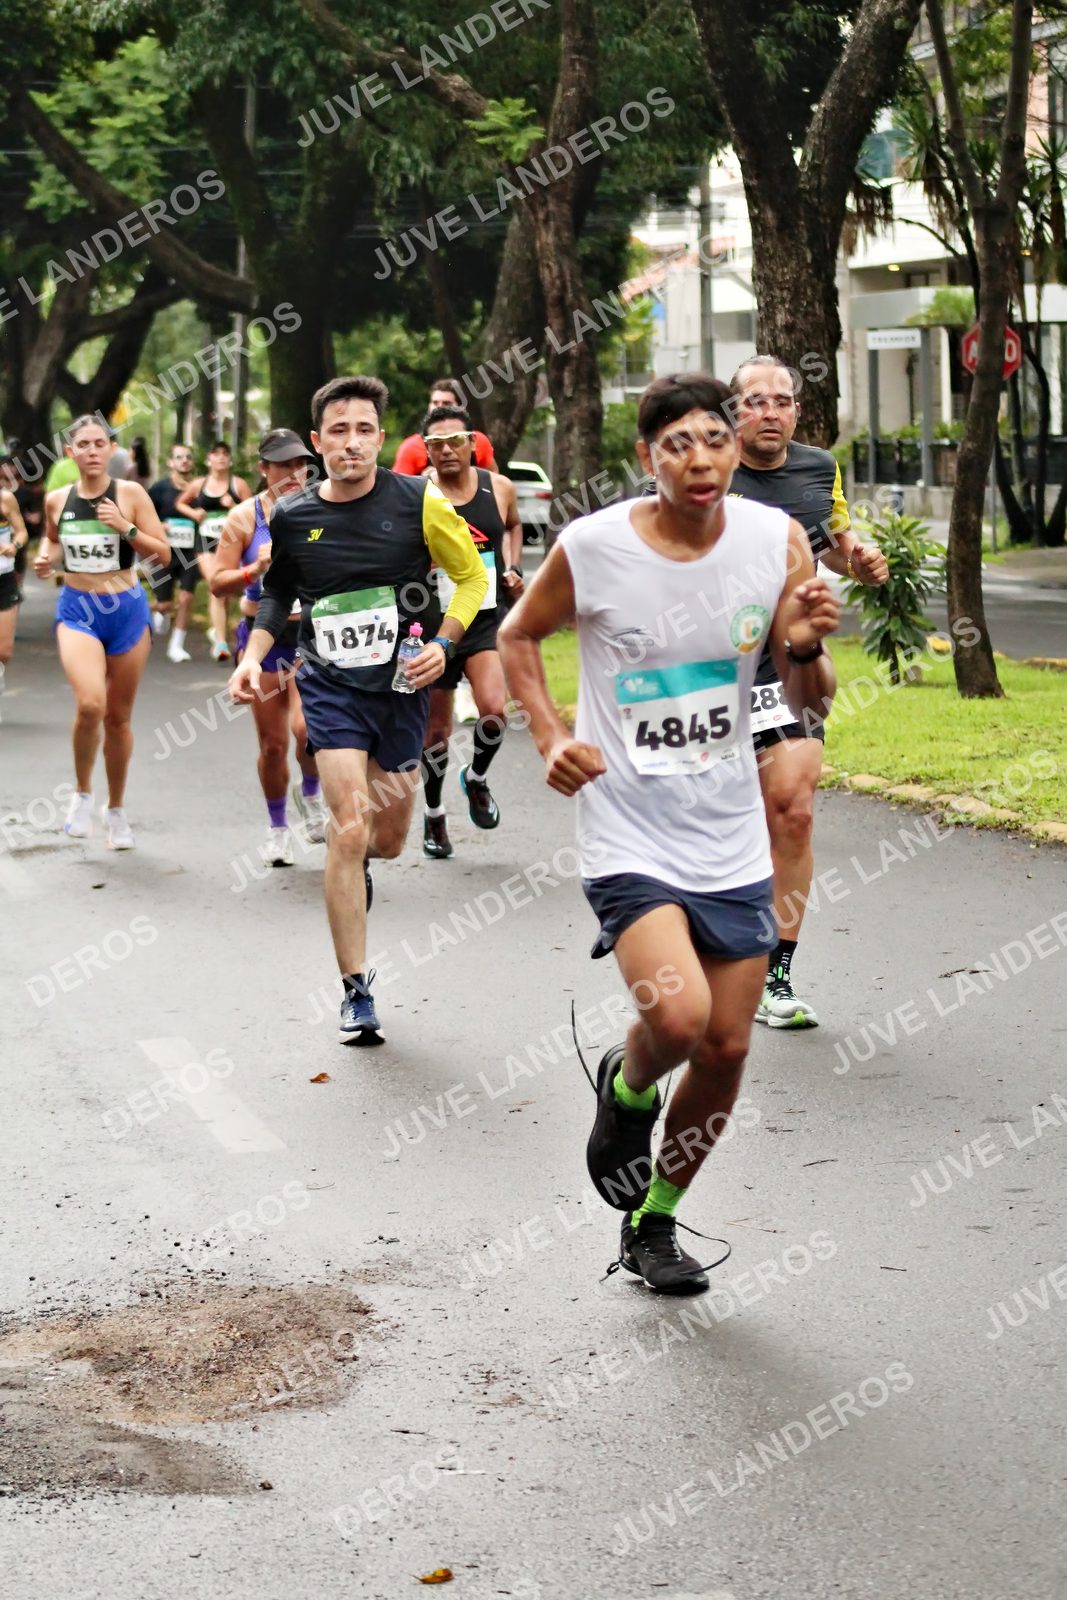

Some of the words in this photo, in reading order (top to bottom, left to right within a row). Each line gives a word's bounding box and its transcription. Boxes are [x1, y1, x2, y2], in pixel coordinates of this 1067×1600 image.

[968, 339, 1016, 363] AO
[67, 544, 115, 560] 1543
[323, 622, 394, 652] 1874
[635, 705, 731, 751] 4845
